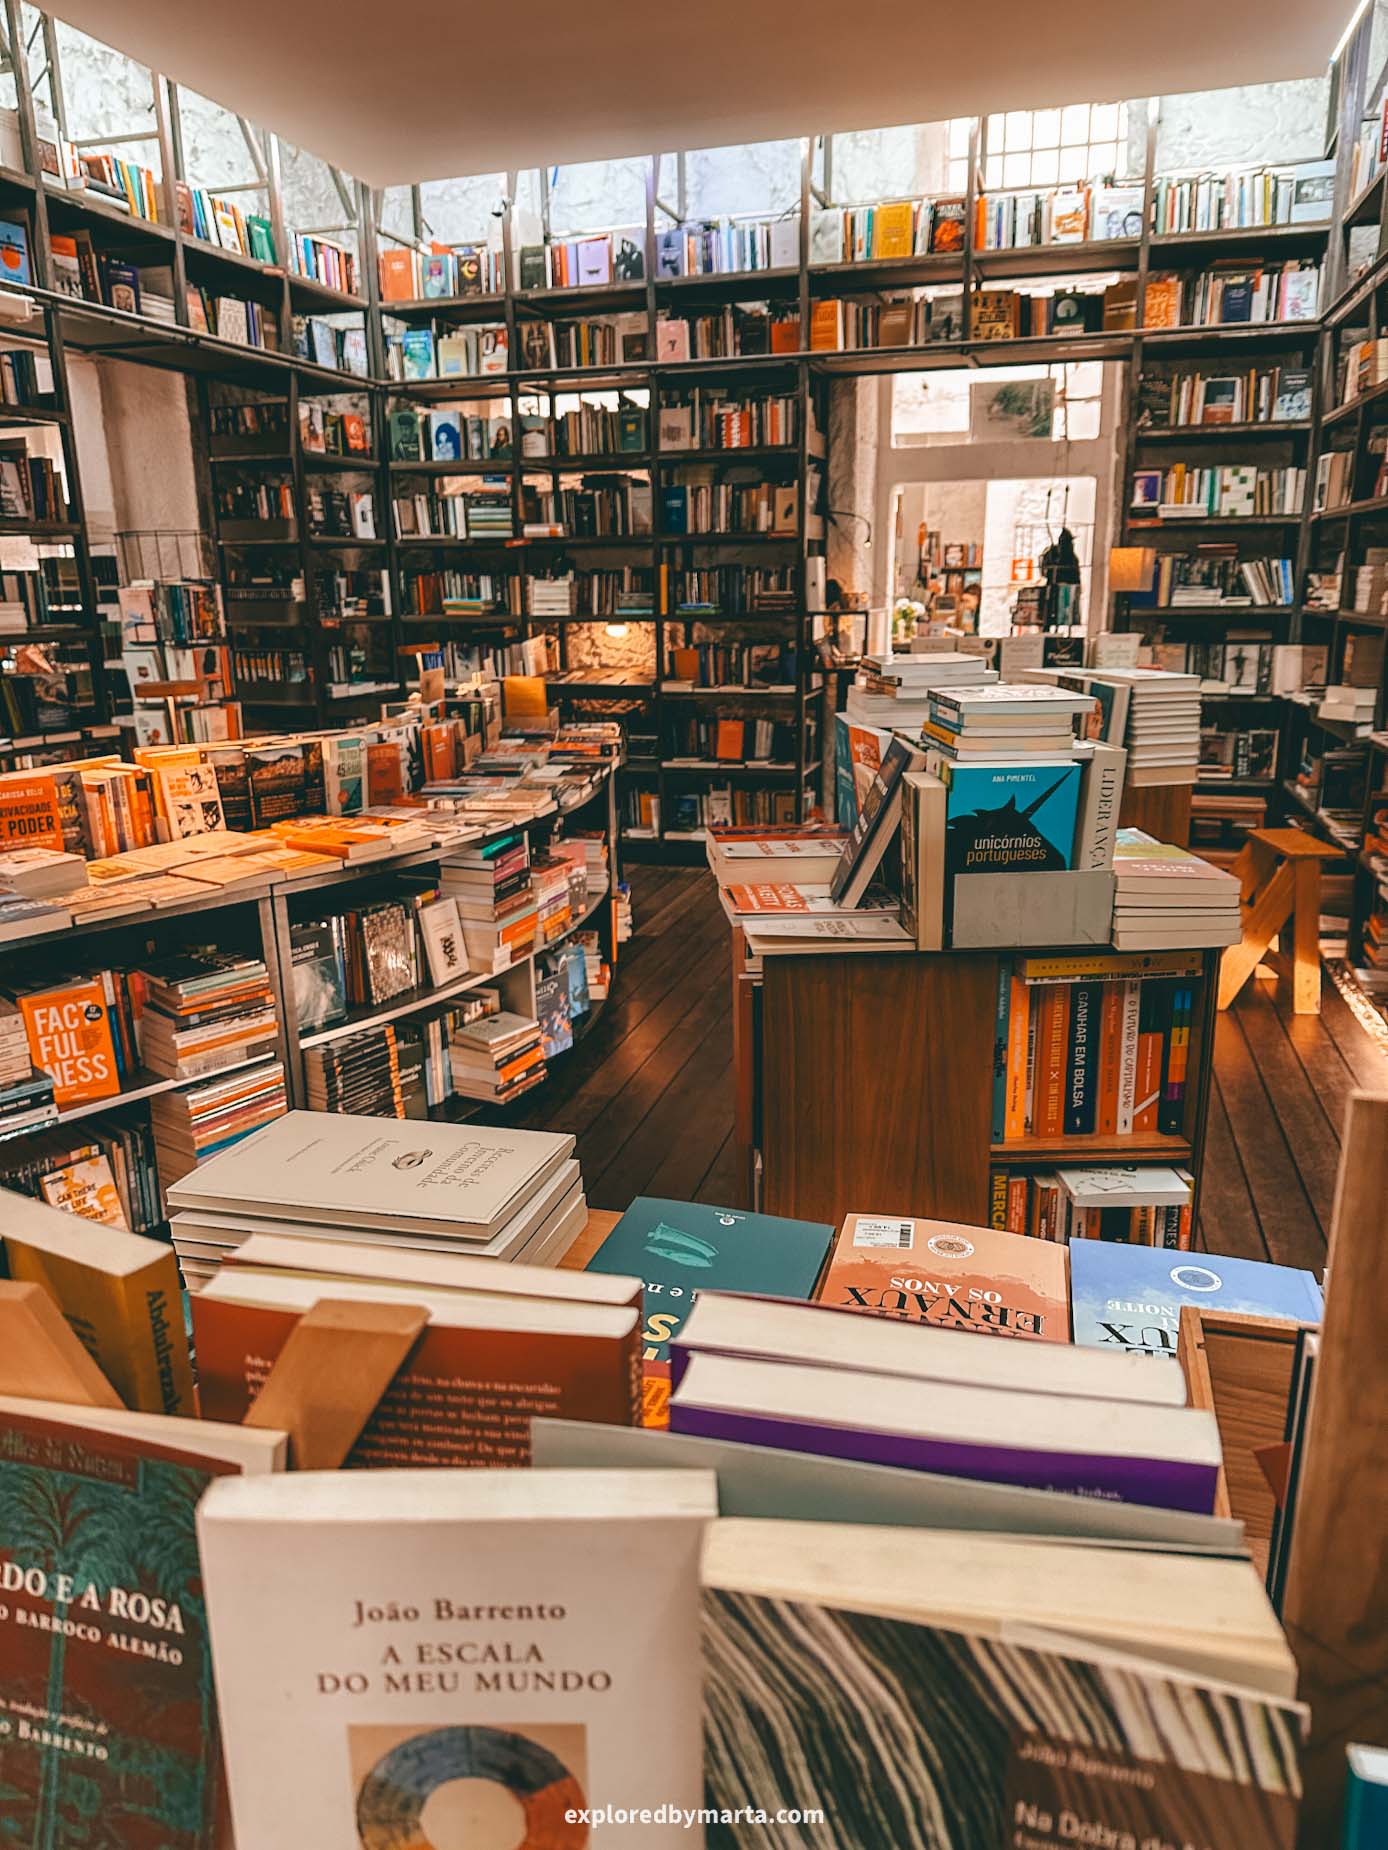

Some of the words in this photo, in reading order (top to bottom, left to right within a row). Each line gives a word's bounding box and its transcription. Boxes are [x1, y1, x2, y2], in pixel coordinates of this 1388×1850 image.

[992, 775, 1005, 783] ANA
[1006, 774, 1036, 783] PIMENTEL
[8, 815, 55, 837] PODER
[1089, 768, 1117, 869] LIDERANÇA
[966, 848, 1047, 866] portugueses
[974, 833, 1042, 850] unicórnios
[33, 1000, 92, 1035] FACT
[1075, 991, 1089, 1044] GANHAR
[1127, 1008, 1137, 1043] FUTURO
[39, 1031, 85, 1063] FUL
[1074, 1046, 1086, 1067] EM
[1125, 1044, 1136, 1056] DO
[44, 1053, 109, 1088] NESS
[1122, 1057, 1135, 1110] CAPITALISMO
[1072, 1068, 1085, 1109] BOLSA
[889, 1276, 962, 1296] ANOS
[967, 1287, 1003, 1304] OS
[841, 1286, 1049, 1337] ERNAUX
[1106, 1299, 1174, 1318] NOITE
[1095, 1321, 1179, 1350] UX
[0, 1562, 48, 1598] DO
[55, 1573, 76, 1604] E
[80, 1582, 101, 1612] A
[109, 1587, 185, 1635] ROSA
[353, 1600, 421, 1628] João
[434, 1597, 568, 1623] Barrento
[15, 1606, 101, 1644] BARROCO
[106, 1631, 184, 1666] ALEMÃO
[381, 1645, 402, 1666] A
[416, 1642, 545, 1666] ESCALA
[316, 1672, 370, 1695] DO
[384, 1671, 460, 1694] MEU
[474, 1669, 613, 1693] MUNDO
[1014, 1800, 1053, 1833] Na
[1058, 1808, 1137, 1850] Dobra
